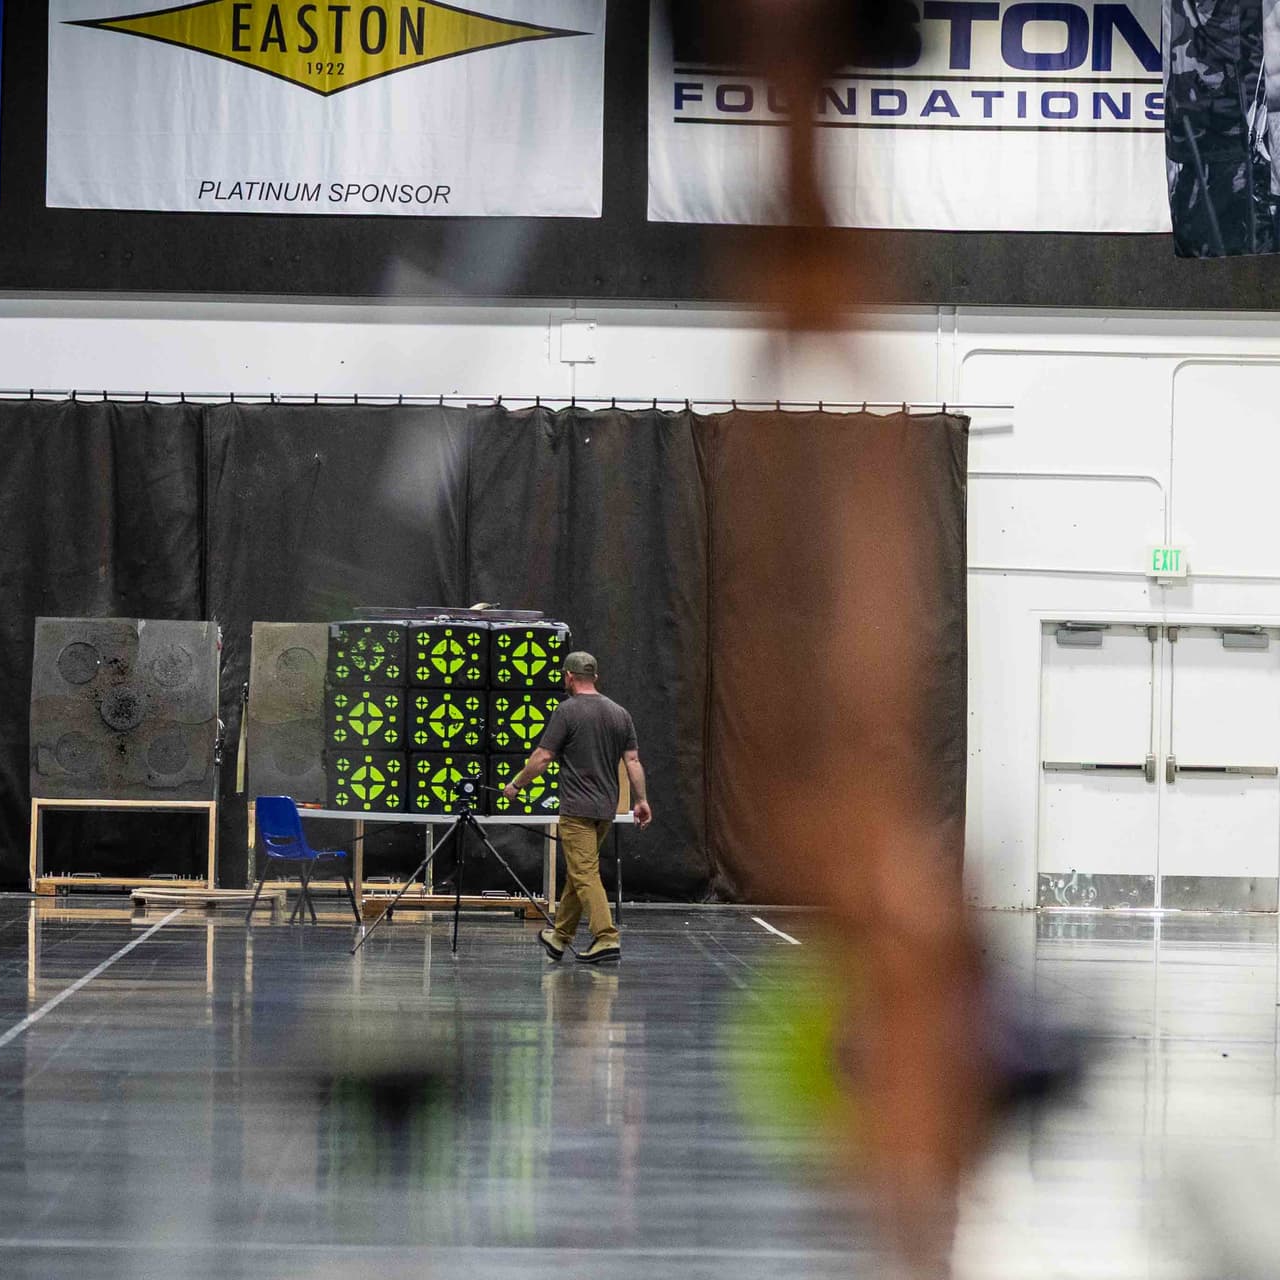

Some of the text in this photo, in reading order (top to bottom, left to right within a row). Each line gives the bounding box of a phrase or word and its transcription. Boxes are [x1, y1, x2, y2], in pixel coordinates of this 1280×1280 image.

[231, 3, 425, 55] EASTON
[307, 62, 345, 75] 1922
[198, 181, 451, 204] PLATINUM SPONSOR
[1153, 549, 1181, 571] EXIT
